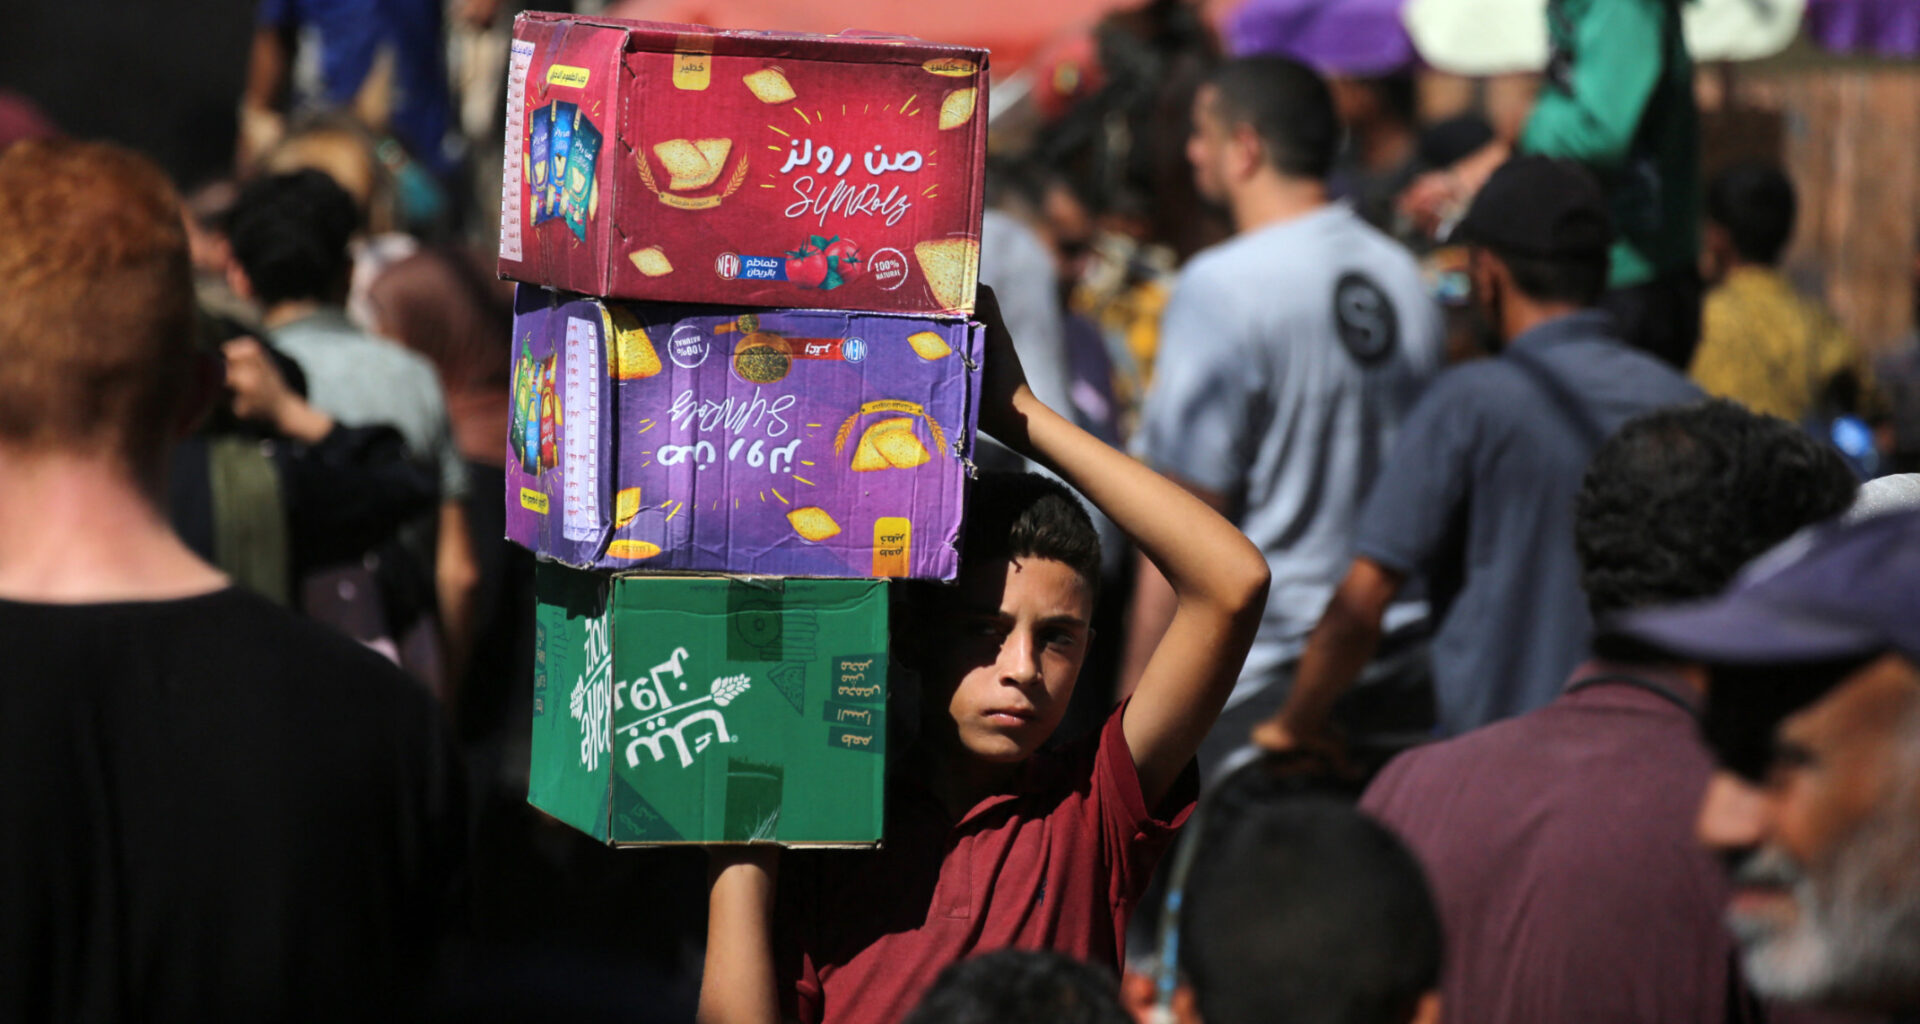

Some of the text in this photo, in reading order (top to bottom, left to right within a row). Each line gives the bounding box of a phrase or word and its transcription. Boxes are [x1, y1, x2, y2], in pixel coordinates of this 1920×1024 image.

[780, 138, 923, 176] صن رولز
[717, 254, 739, 278] NEW
[746, 258, 778, 268] طماطم
[874, 260, 900, 272] 100%
[875, 269, 901, 280] NATURAL
[677, 343, 703, 356] 100%
[845, 339, 865, 361] NEW
[656, 438, 802, 474] صن رولز
[880, 546, 903, 557] طعم
[840, 659, 873, 672] محمر
[614, 647, 689, 711] رولز
[841, 673, 865, 688] مش
[838, 684, 881, 697] محمص
[625, 709, 730, 768] بيك
[841, 734, 873, 748] طعم
